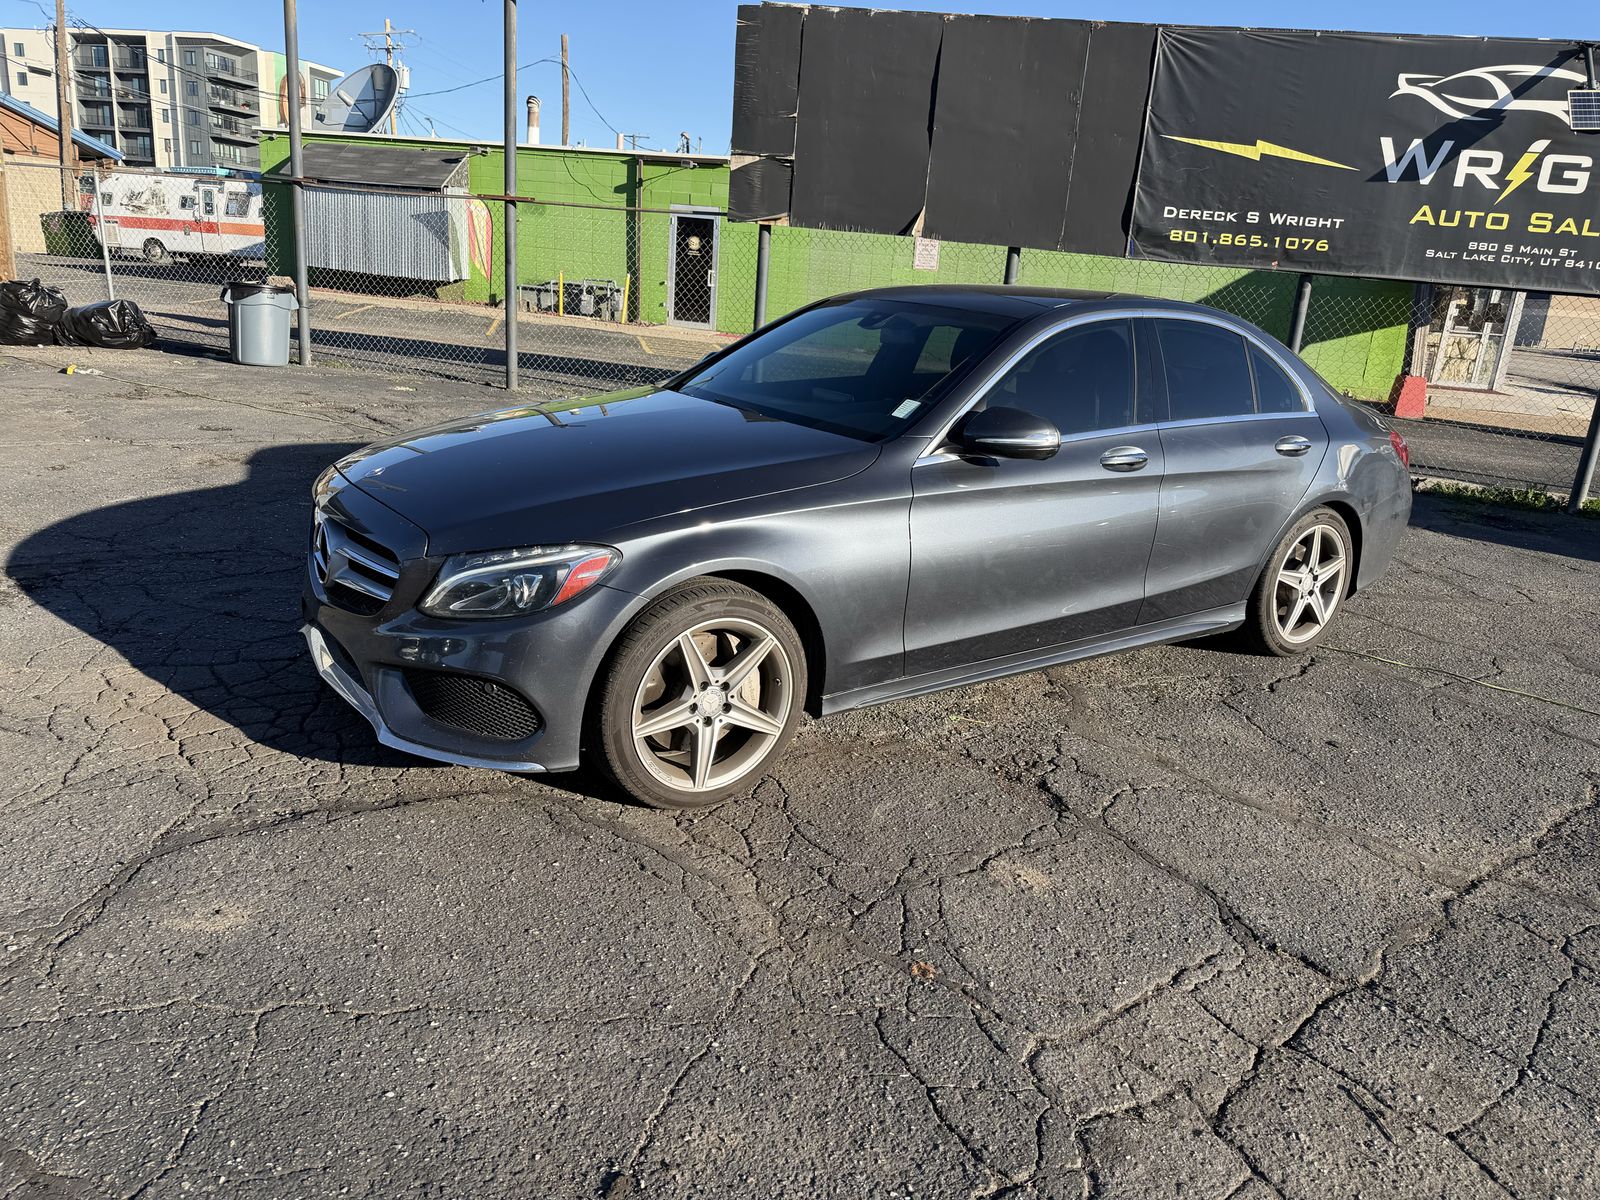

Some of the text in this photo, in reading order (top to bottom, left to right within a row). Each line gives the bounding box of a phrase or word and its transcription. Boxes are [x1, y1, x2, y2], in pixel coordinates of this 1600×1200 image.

[1163, 206, 1345, 229] DERECK S WRIGHT
[1408, 204, 1510, 231] AUTO
[1169, 229, 1329, 252] 801.865.1076
[1467, 241, 1578, 258] 880 S MAIN ST
[1425, 249, 1458, 260] SALT
[1462, 251, 1496, 263] LAKE
[1500, 254, 1534, 267] CITY,
[1539, 257, 1561, 267] UT
